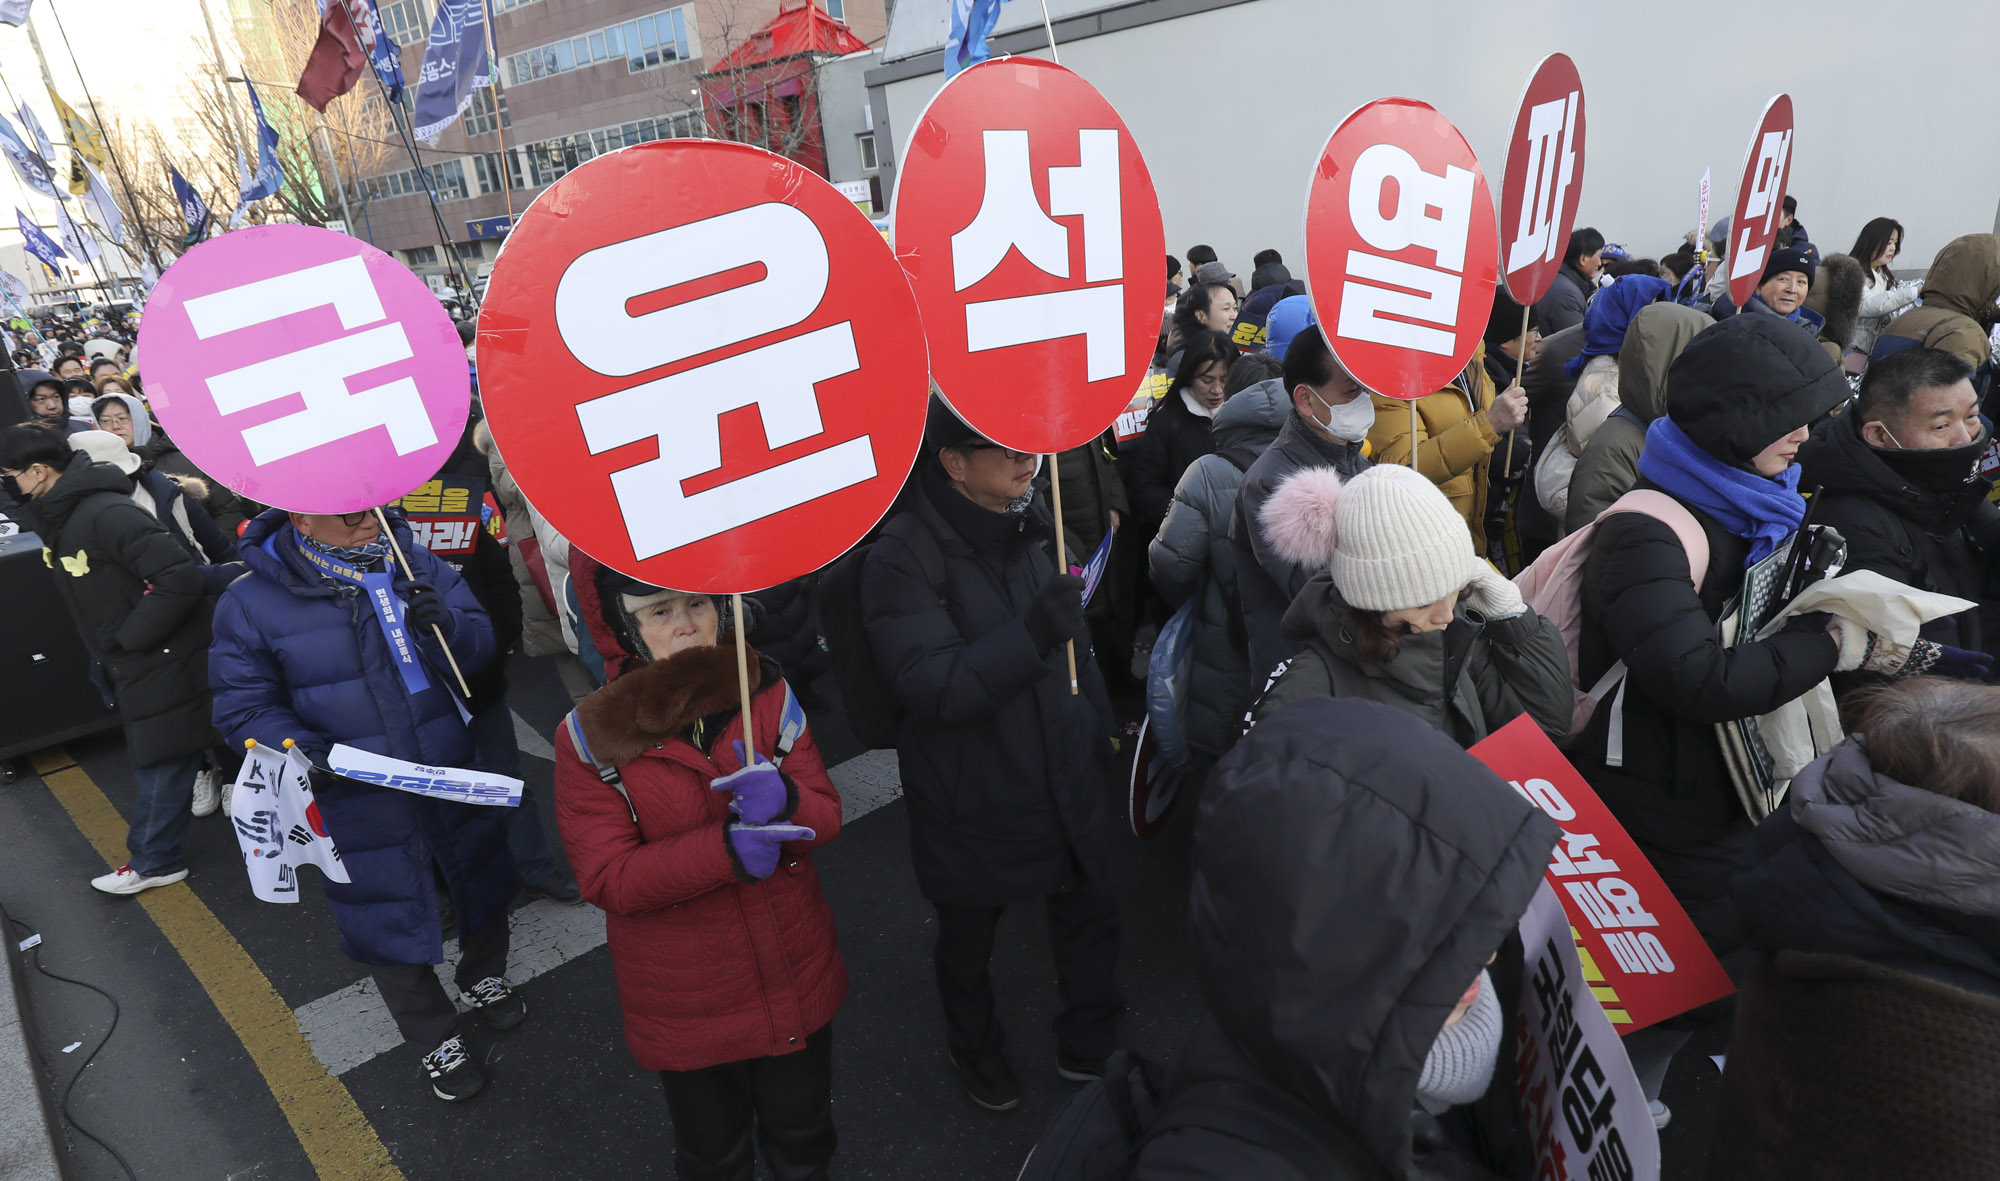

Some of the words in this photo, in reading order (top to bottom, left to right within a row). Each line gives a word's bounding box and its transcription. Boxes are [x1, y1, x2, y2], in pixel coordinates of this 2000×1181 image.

[952, 130, 1125, 383] 석
[1337, 143, 1476, 356] 열
[1507, 91, 1579, 274] 파
[1731, 129, 1792, 281] 면
[183, 255, 438, 466] 국
[556, 203, 877, 560] 윤
